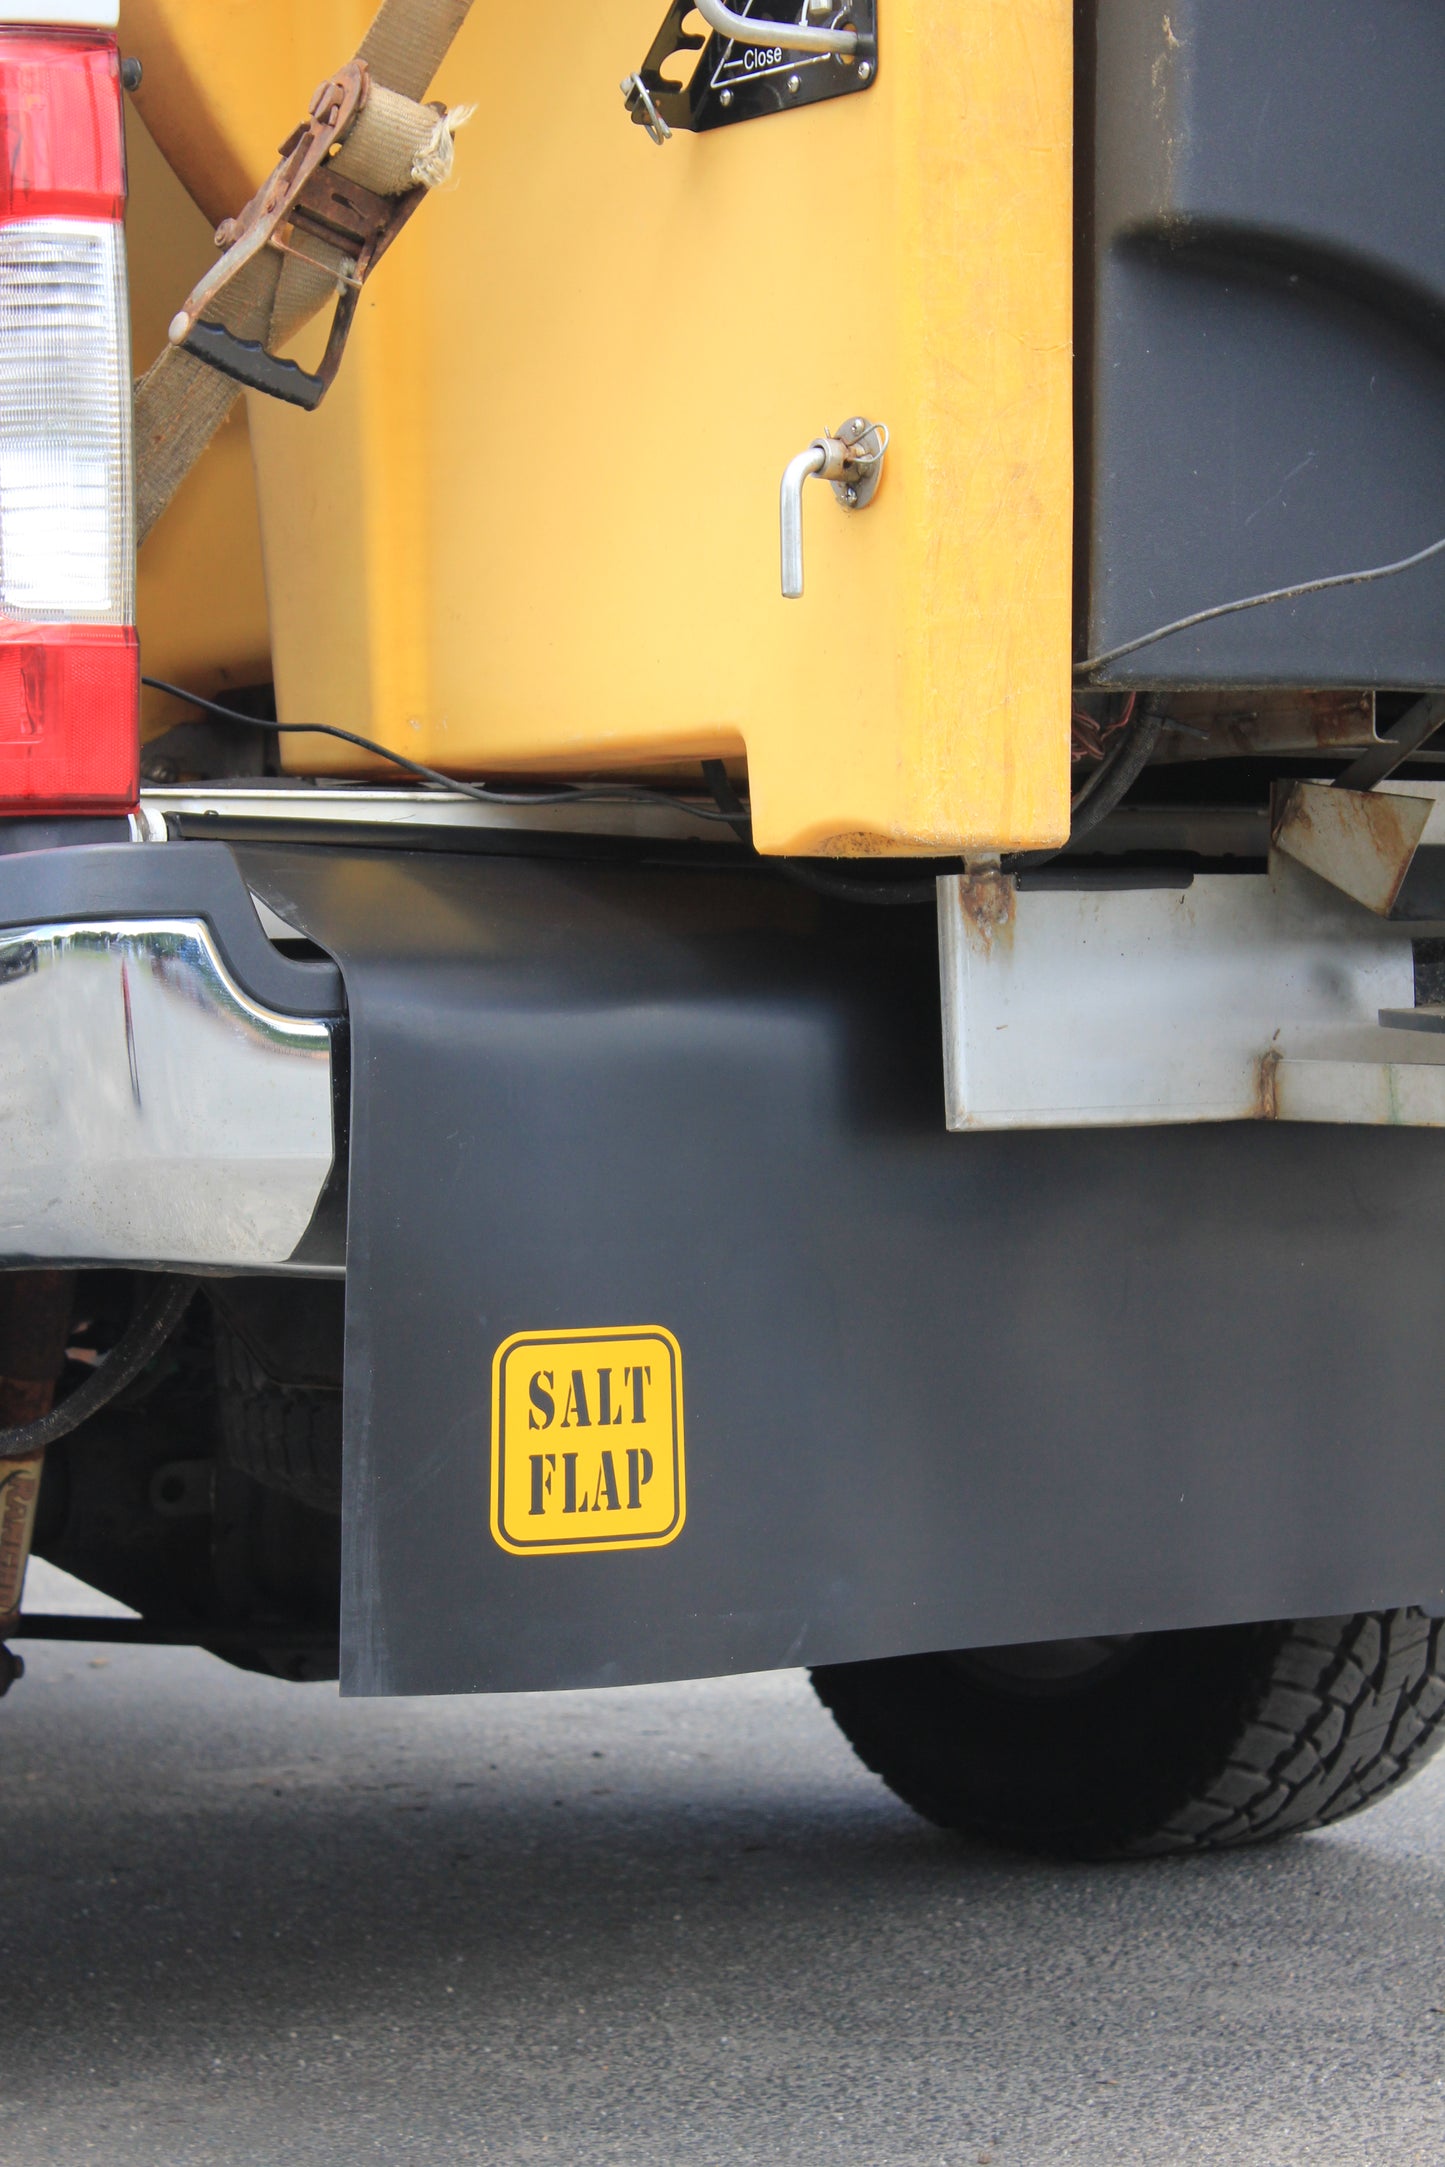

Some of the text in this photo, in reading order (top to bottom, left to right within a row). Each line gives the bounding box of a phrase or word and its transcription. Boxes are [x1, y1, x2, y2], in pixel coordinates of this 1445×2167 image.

[744, 47, 782, 70] Close
[528, 1366, 651, 1430] SALT
[528, 1448, 654, 1516] FLAP
